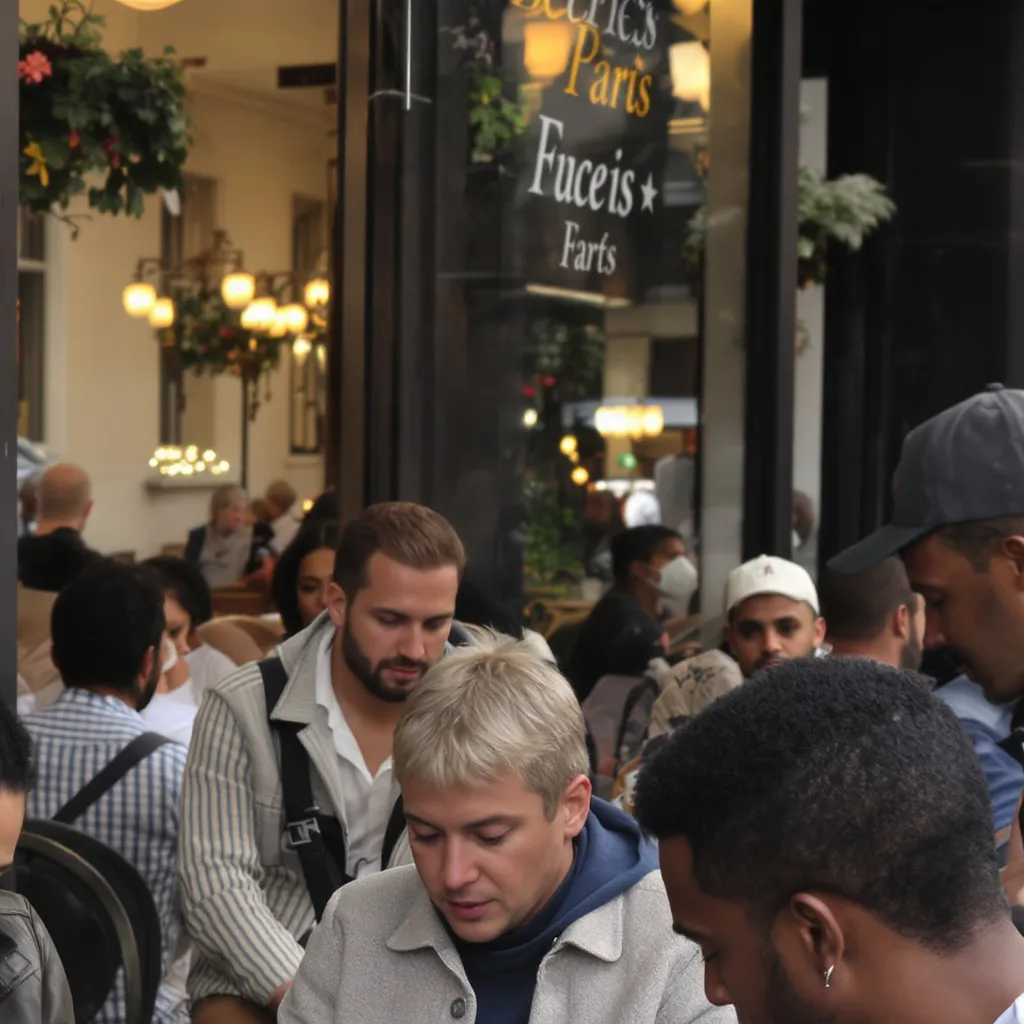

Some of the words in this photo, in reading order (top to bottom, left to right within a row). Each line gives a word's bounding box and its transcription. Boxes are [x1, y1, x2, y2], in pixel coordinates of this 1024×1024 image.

[564, 23, 652, 117] Paris
[527, 114, 636, 217] Fuceis
[559, 220, 617, 275] Farts
